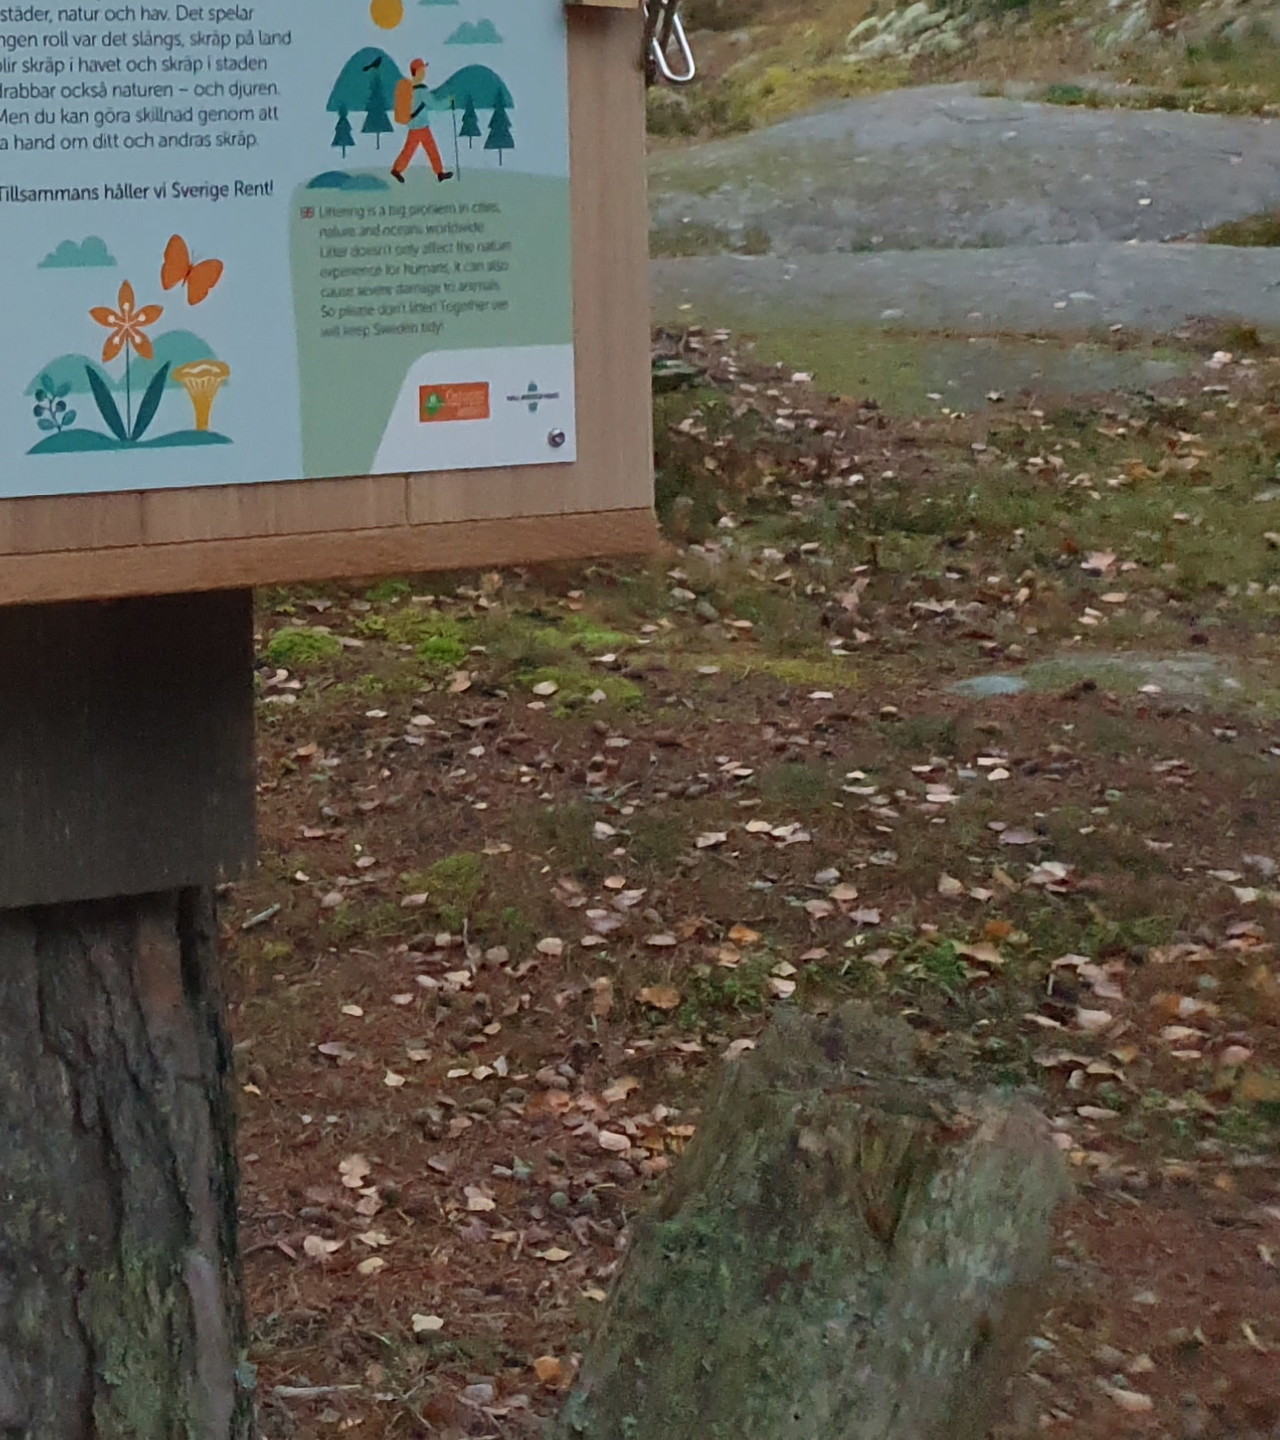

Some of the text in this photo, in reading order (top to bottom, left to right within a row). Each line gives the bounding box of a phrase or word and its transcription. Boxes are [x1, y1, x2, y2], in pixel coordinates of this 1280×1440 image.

[0, 4, 53, 24] städer,
[57, 7, 99, 22] natur
[104, 5, 135, 21] och
[140, 4, 172, 21] hav.
[175, 4, 203, 21] Det
[208, 3, 255, 23] spelar
[42, 31, 69, 47] roll
[72, 34, 97, 47] var
[101, 30, 127, 47] det
[132, 30, 186, 50] slängs,
[189, 29, 231, 49] skräp
[235, 29, 255, 49] på
[258, 29, 291, 46] land
[21, 56, 64, 76] skräp
[69, 57, 73, 73] i
[78, 56, 122, 73] havet
[126, 56, 157, 72] och
[161, 55, 203, 75] skräp
[207, 56, 211, 71] i
[215, 55, 267, 71] staden
[60, 80, 108, 98] också
[112, 83, 173, 98] naturen
[194, 82, 224, 97] och
[228, 81, 280, 100] djuren.
[34, 108, 56, 124] du
[60, 108, 89, 124] kan
[94, 107, 130, 128] göra
[135, 106, 193, 123] skillnad
[198, 108, 254, 126] genom
[258, 106, 279, 121] att
[14, 133, 55, 150] hand
[60, 136, 88, 150] om
[92, 132, 119, 149] ditt
[123, 132, 154, 148] och
[158, 131, 211, 148] andras
[215, 130, 259, 150] skräp.
[104, 182, 148, 201] håller
[153, 182, 167, 199] vi
[171, 180, 229, 202] Sverige
[233, 179, 274, 198] Rent!
